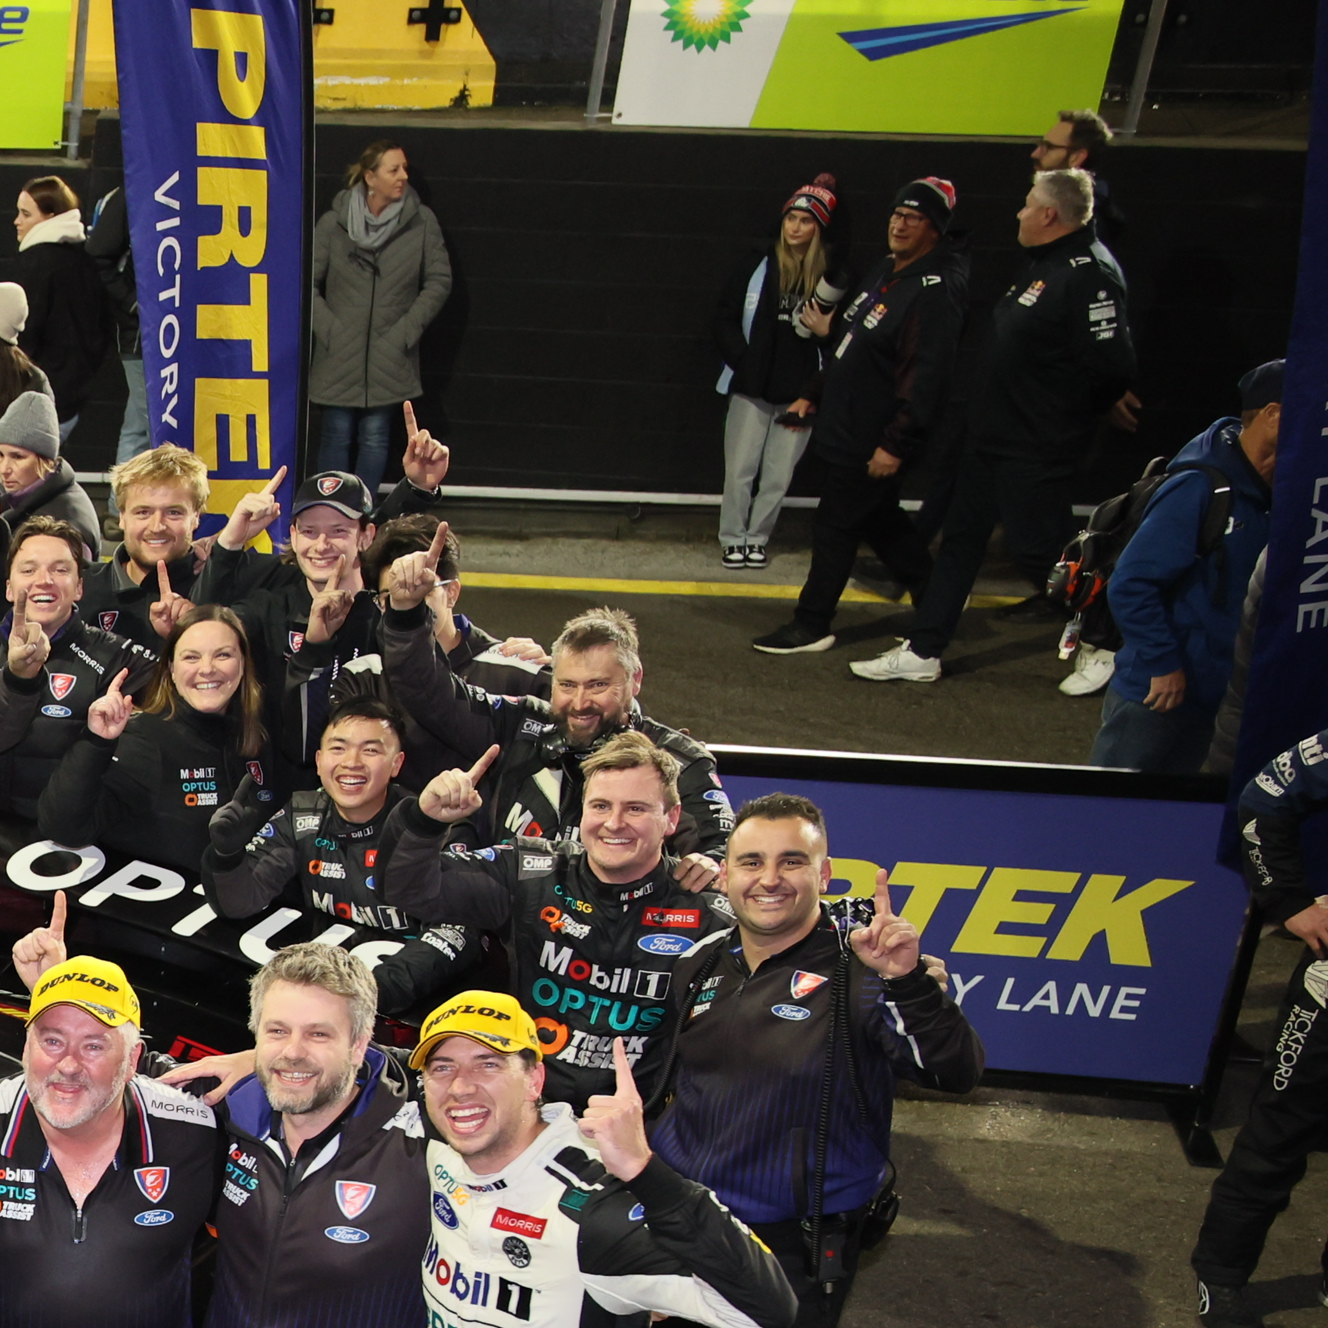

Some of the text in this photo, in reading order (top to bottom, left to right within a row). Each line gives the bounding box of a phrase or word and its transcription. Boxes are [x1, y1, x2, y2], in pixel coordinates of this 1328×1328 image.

[191, 8, 271, 555] PIRTE
[153, 170, 182, 430] VICTORY
[1295, 476, 1328, 634] LANE
[69, 642, 105, 675] MORRIS
[180, 768, 205, 779] Mobil
[182, 781, 217, 792] OPTUS
[197, 793, 218, 801] TRUCK
[296, 816, 320, 830] OMP
[523, 857, 553, 870] OMP
[312, 889, 379, 927] Mobil
[830, 858, 1196, 968] TEK
[421, 932, 456, 961] Coates
[649, 937, 683, 952] Ford
[539, 940, 631, 993] Mobil
[36, 971, 121, 998] DUNLOP
[531, 977, 666, 1031] OPTUS
[777, 1004, 806, 1018] Ford
[995, 976, 1147, 1022] LANE
[424, 1004, 512, 1036] DUNLOP
[1275, 1003, 1299, 1053] RACING
[1273, 1008, 1319, 1092] TICKFORD
[150, 1099, 209, 1120] MORRIS
[225, 1180, 251, 1200] TRUCK
[434, 1164, 471, 1207] OPTU5G
[0, 1210, 34, 1221] ASSIST
[3, 1201, 36, 1213] TRUCK
[142, 1211, 167, 1224] Ford
[332, 1228, 361, 1242] Ford
[496, 1213, 542, 1233] MORRIS
[422, 1233, 491, 1307] Mobil
